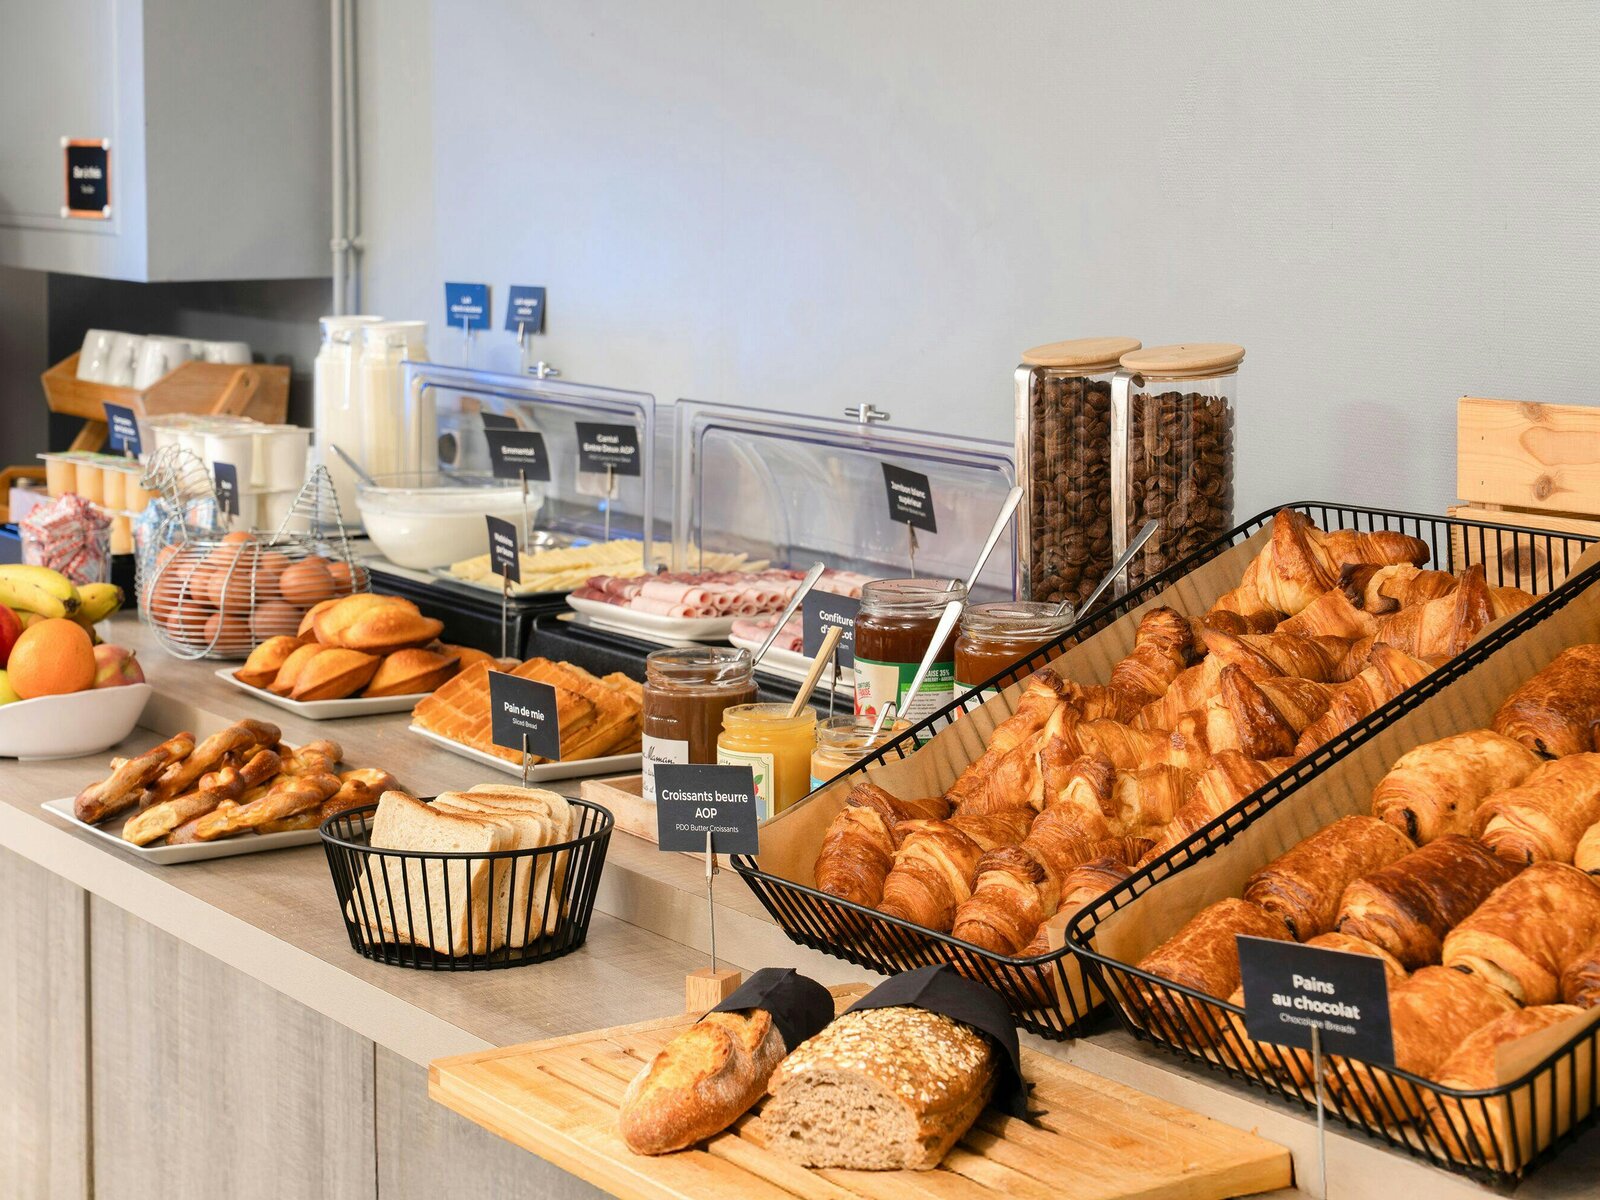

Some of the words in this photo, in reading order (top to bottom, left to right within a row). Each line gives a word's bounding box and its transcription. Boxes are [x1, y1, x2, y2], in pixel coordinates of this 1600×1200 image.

[501, 445, 535, 456] Emmental
[819, 610, 854, 627] Confiture
[504, 701, 519, 714] Pain
[520, 706, 530, 717] de
[531, 709, 545, 721] mie
[512, 717, 525, 726] Sliced
[525, 721, 538, 730] Bread
[661, 789, 713, 802] Croissants
[714, 790, 748, 803] beurre
[695, 807, 717, 819] AOP
[675, 823, 690, 831] PDO
[690, 824, 709, 832] Butter
[709, 825, 739, 833] Croissants
[1292, 974, 1335, 995] Pains
[1272, 993, 1292, 1008] au
[1293, 995, 1361, 1020] chocolat
[1279, 1012, 1324, 1029] Chocolate
[1324, 1020, 1357, 1035] Breads
